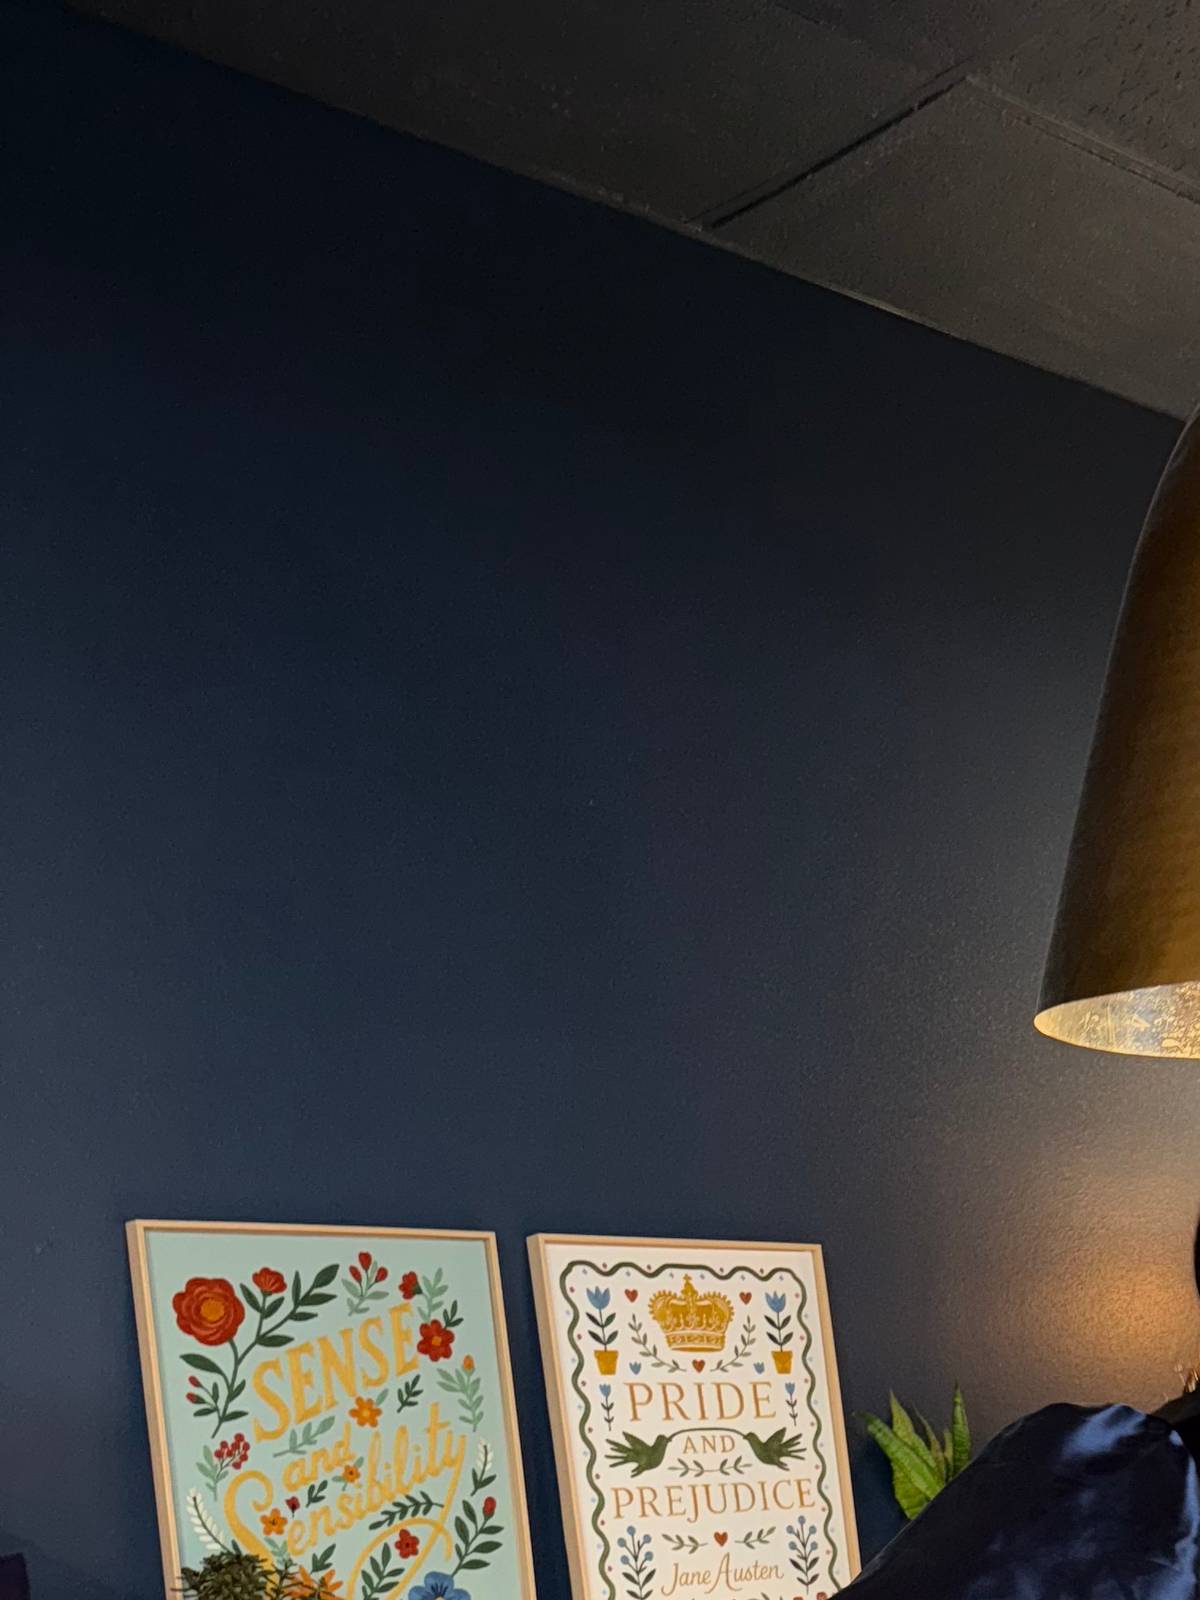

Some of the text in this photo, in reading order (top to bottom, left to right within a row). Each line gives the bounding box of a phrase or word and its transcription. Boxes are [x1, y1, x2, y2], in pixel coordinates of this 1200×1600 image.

[252, 1303, 422, 1443] SENSE
[623, 1381, 777, 1422] PRIDE
[282, 1423, 356, 1490] and
[682, 1434, 736, 1454] AND
[610, 1477, 817, 1523] PREJUDICE
[660, 1552, 785, 1598] Jane Austen
